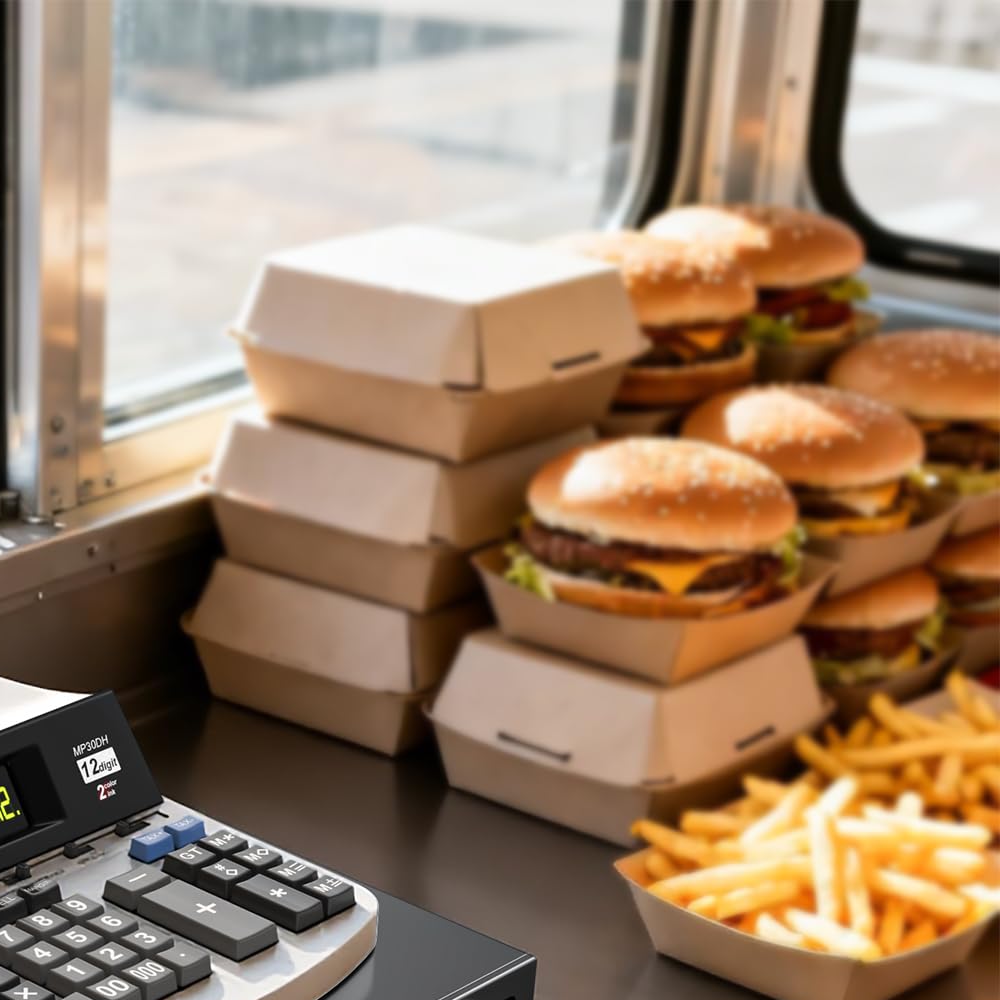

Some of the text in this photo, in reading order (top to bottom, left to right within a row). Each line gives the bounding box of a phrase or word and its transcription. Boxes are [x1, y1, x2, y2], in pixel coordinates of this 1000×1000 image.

[72, 734, 109, 757] MP30DH
[180, 846, 203, 859] GT
[66, 900, 88, 910] 9
[31, 915, 53, 926] 8
[101, 915, 122, 926] 6
[66, 931, 87, 942] 5
[134, 932, 156, 943] 3
[34, 947, 51, 958] 4
[100, 948, 123, 960] 2
[67, 964, 85, 975] 1
[130, 961, 165, 980] 000
[96, 979, 130, 997] 00
